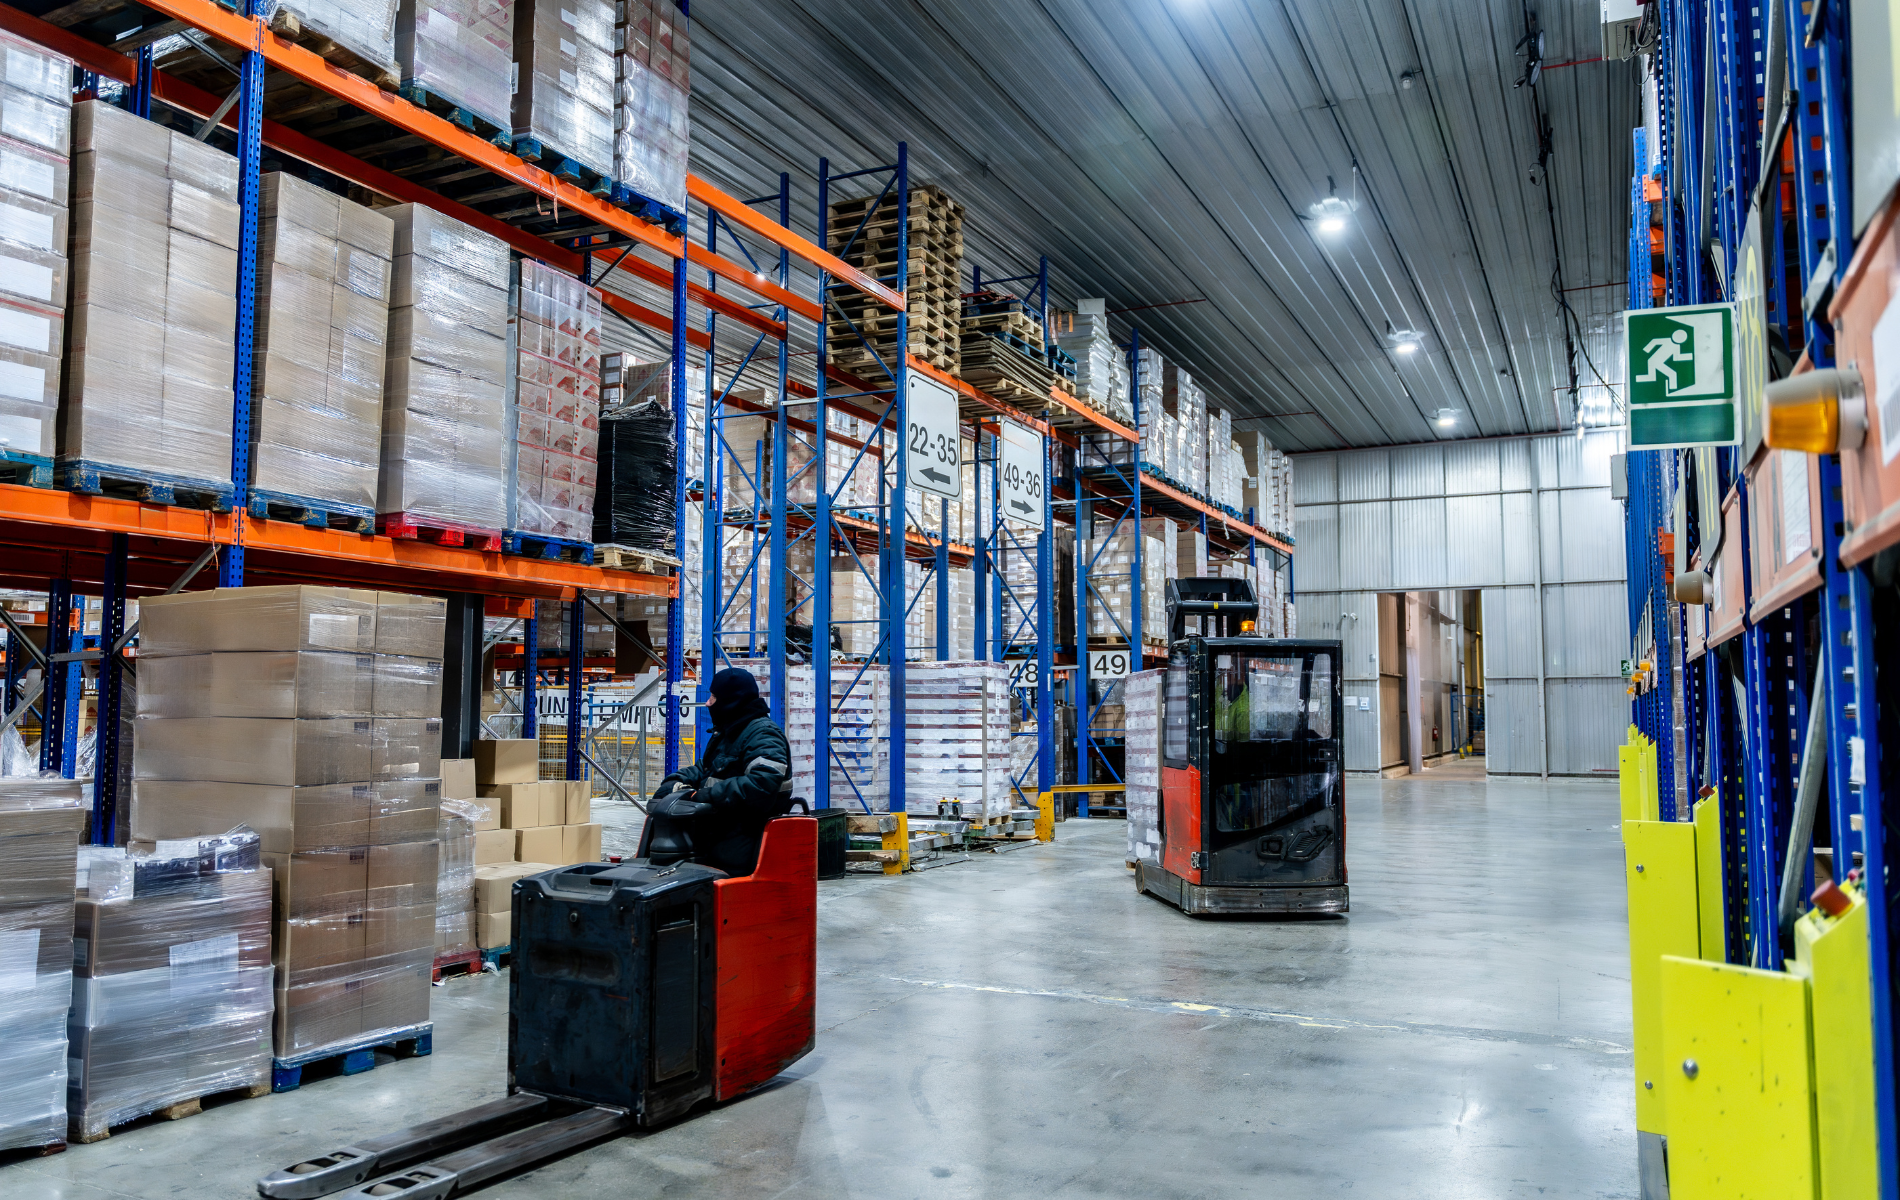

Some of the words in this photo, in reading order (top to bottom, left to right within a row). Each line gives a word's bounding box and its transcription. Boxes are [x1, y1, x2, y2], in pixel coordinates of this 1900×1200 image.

[909, 422, 957, 466] 22-35
[1004, 462, 1041, 499] 49-36
[1010, 663, 1038, 683] 48
[1094, 654, 1126, 675] 49
[534, 696, 590, 720] UNO
